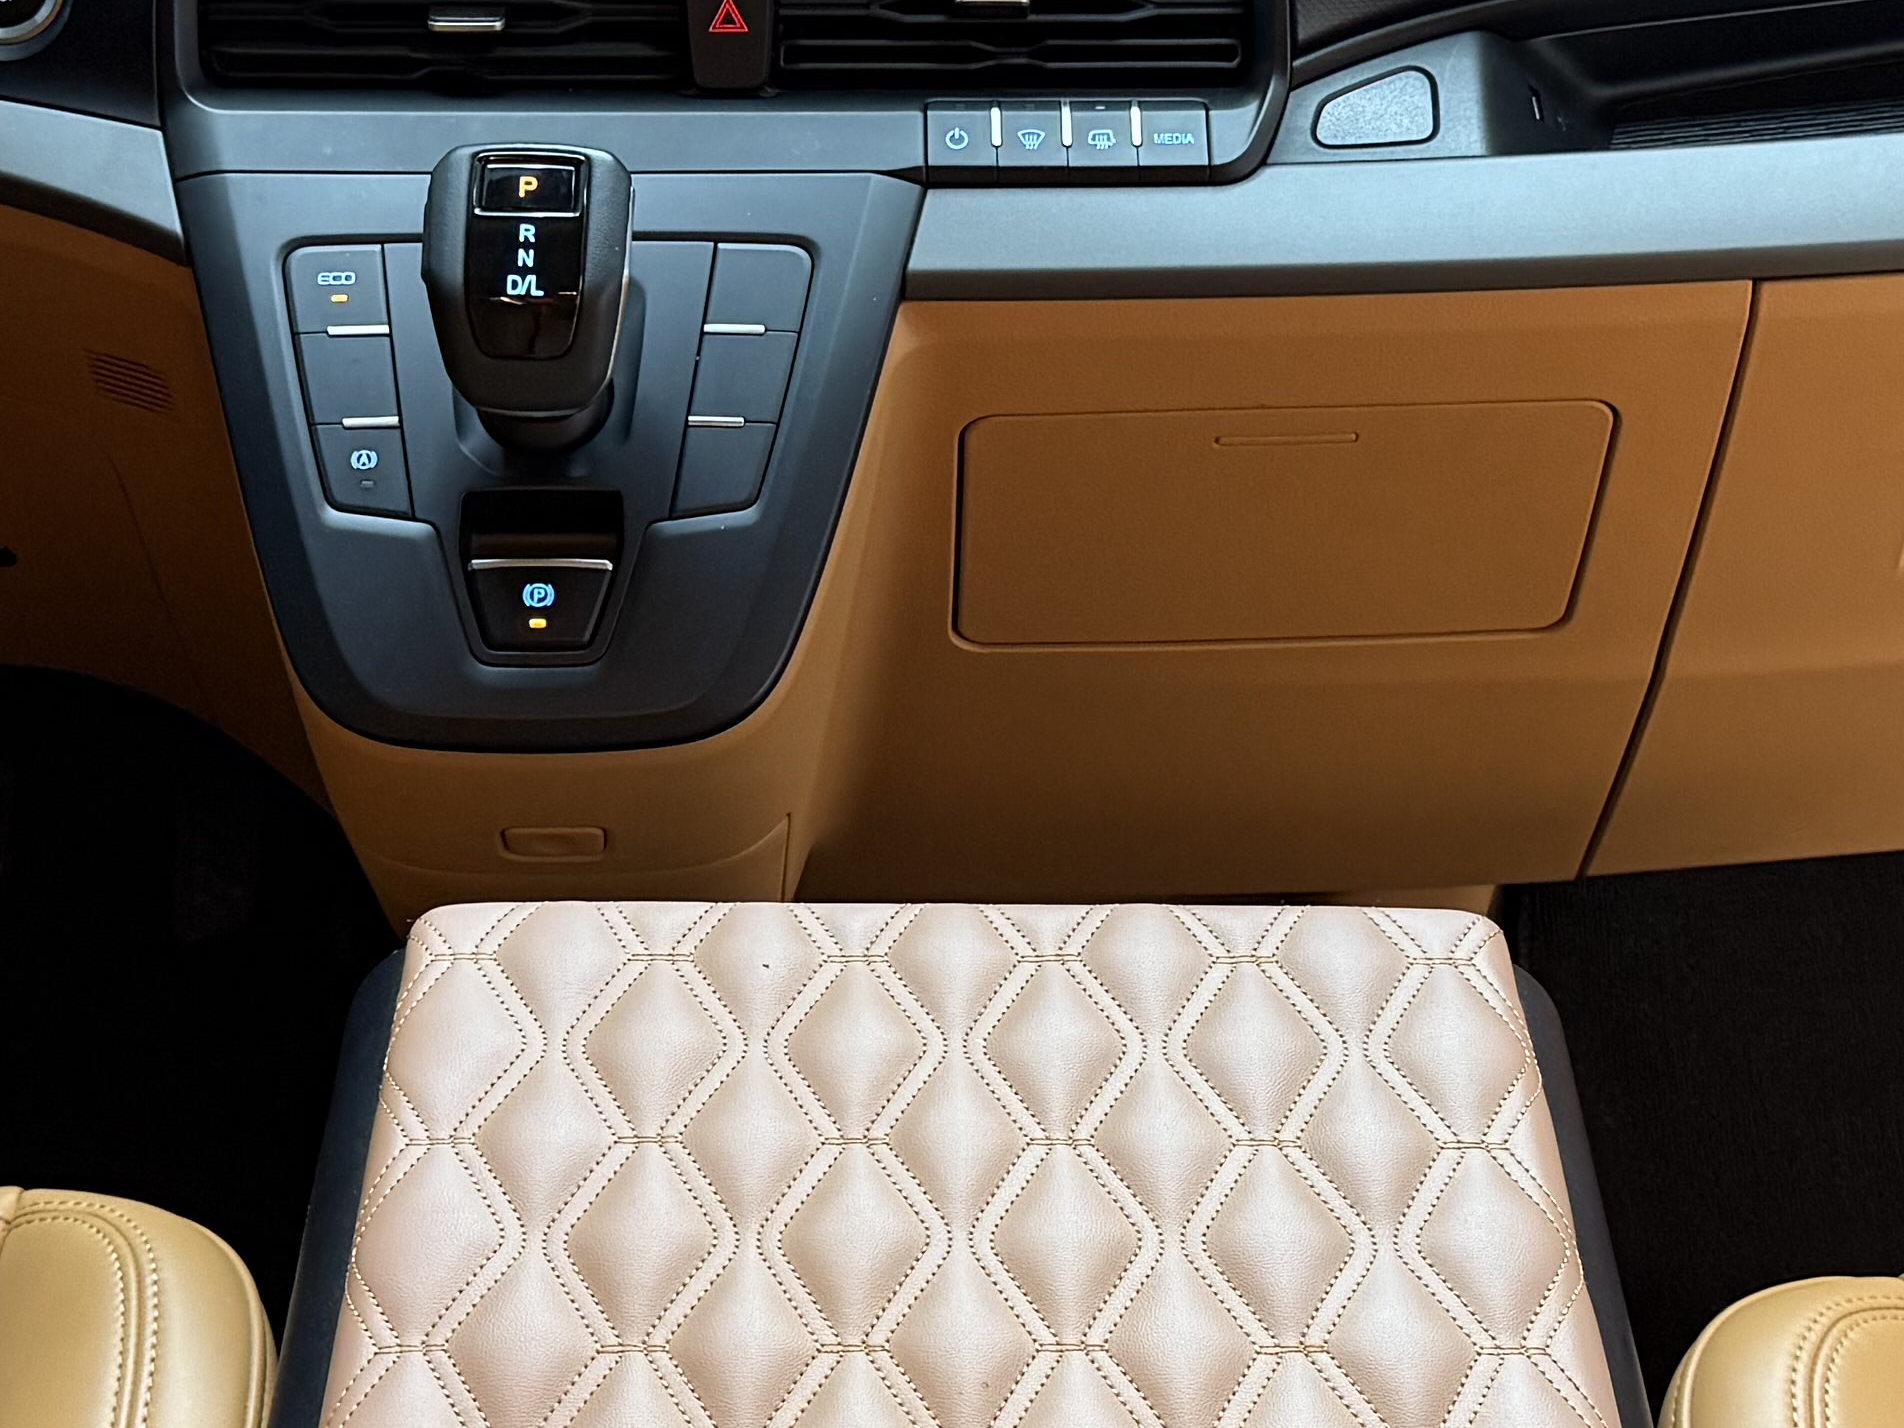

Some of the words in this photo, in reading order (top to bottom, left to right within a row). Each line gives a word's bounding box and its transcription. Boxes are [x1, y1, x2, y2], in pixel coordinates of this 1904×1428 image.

[1153, 132, 1195, 145] MEDIA
[518, 176, 539, 198] P
[519, 223, 536, 243] R
[517, 248, 535, 267] N
[317, 271, 356, 286] ECO
[506, 274, 544, 296] D/L
